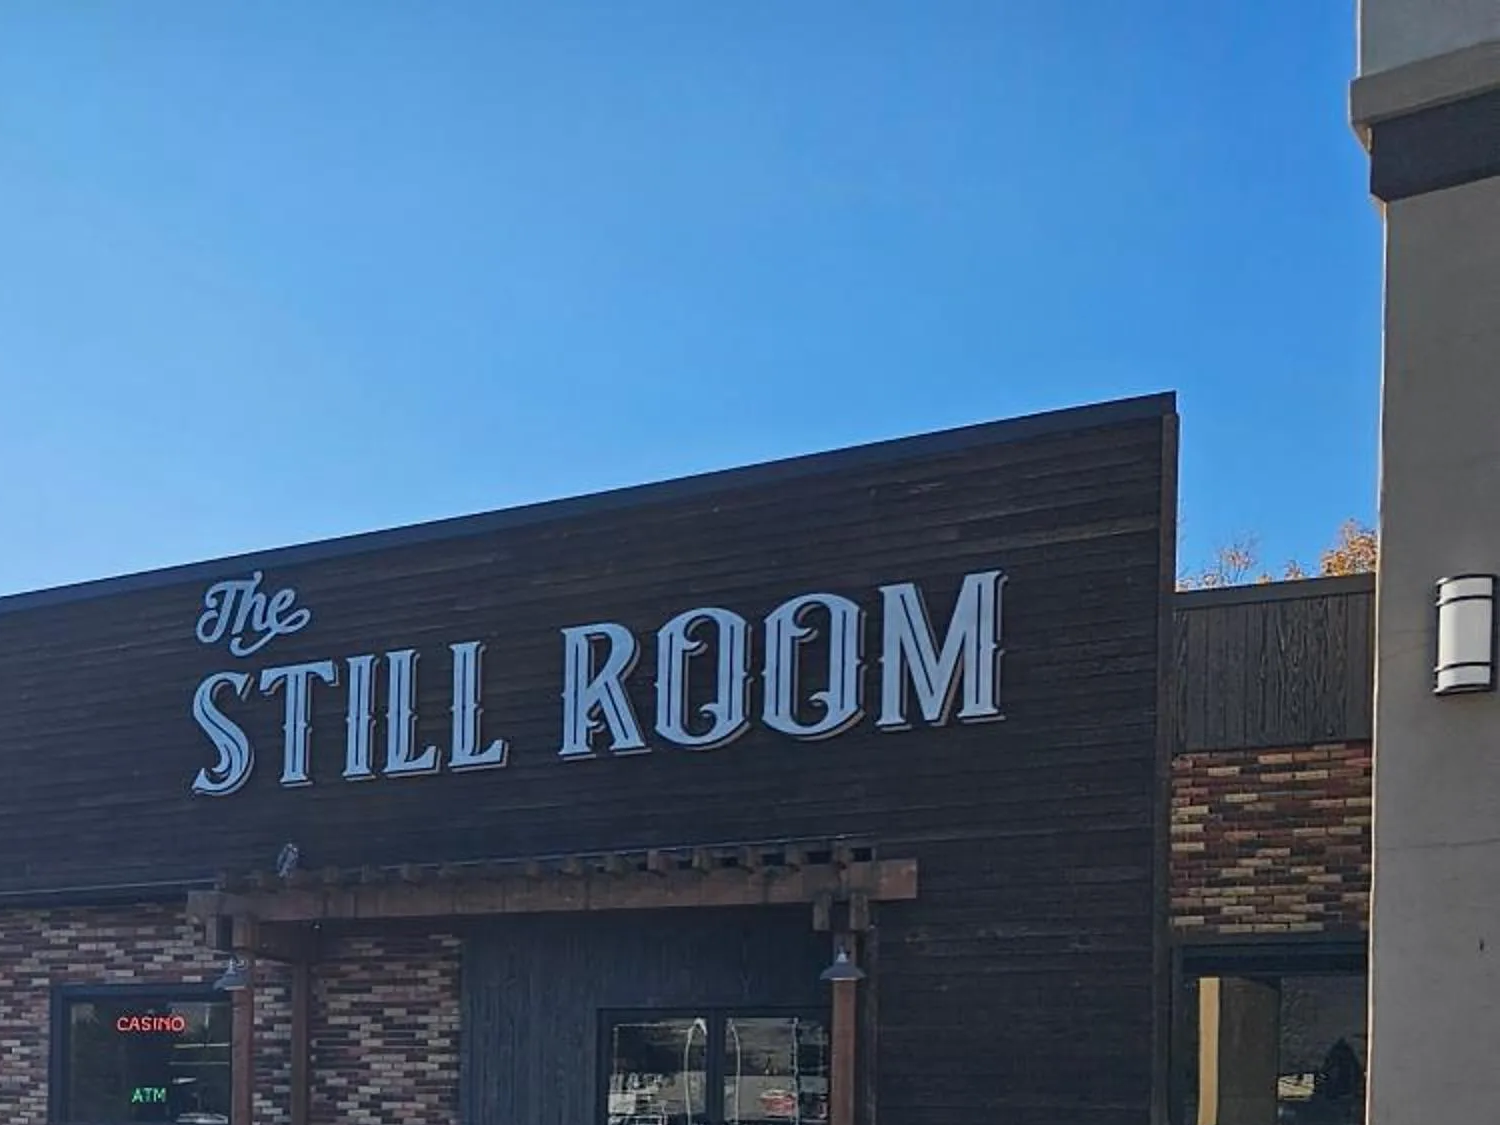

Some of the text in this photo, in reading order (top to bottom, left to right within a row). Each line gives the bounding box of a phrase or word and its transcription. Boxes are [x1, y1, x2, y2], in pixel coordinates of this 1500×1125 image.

[196, 571, 311, 656] The
[192, 569, 1008, 797] STILL ROOM
[116, 1016, 185, 1032] CASINO
[131, 1087, 166, 1103] ATM
